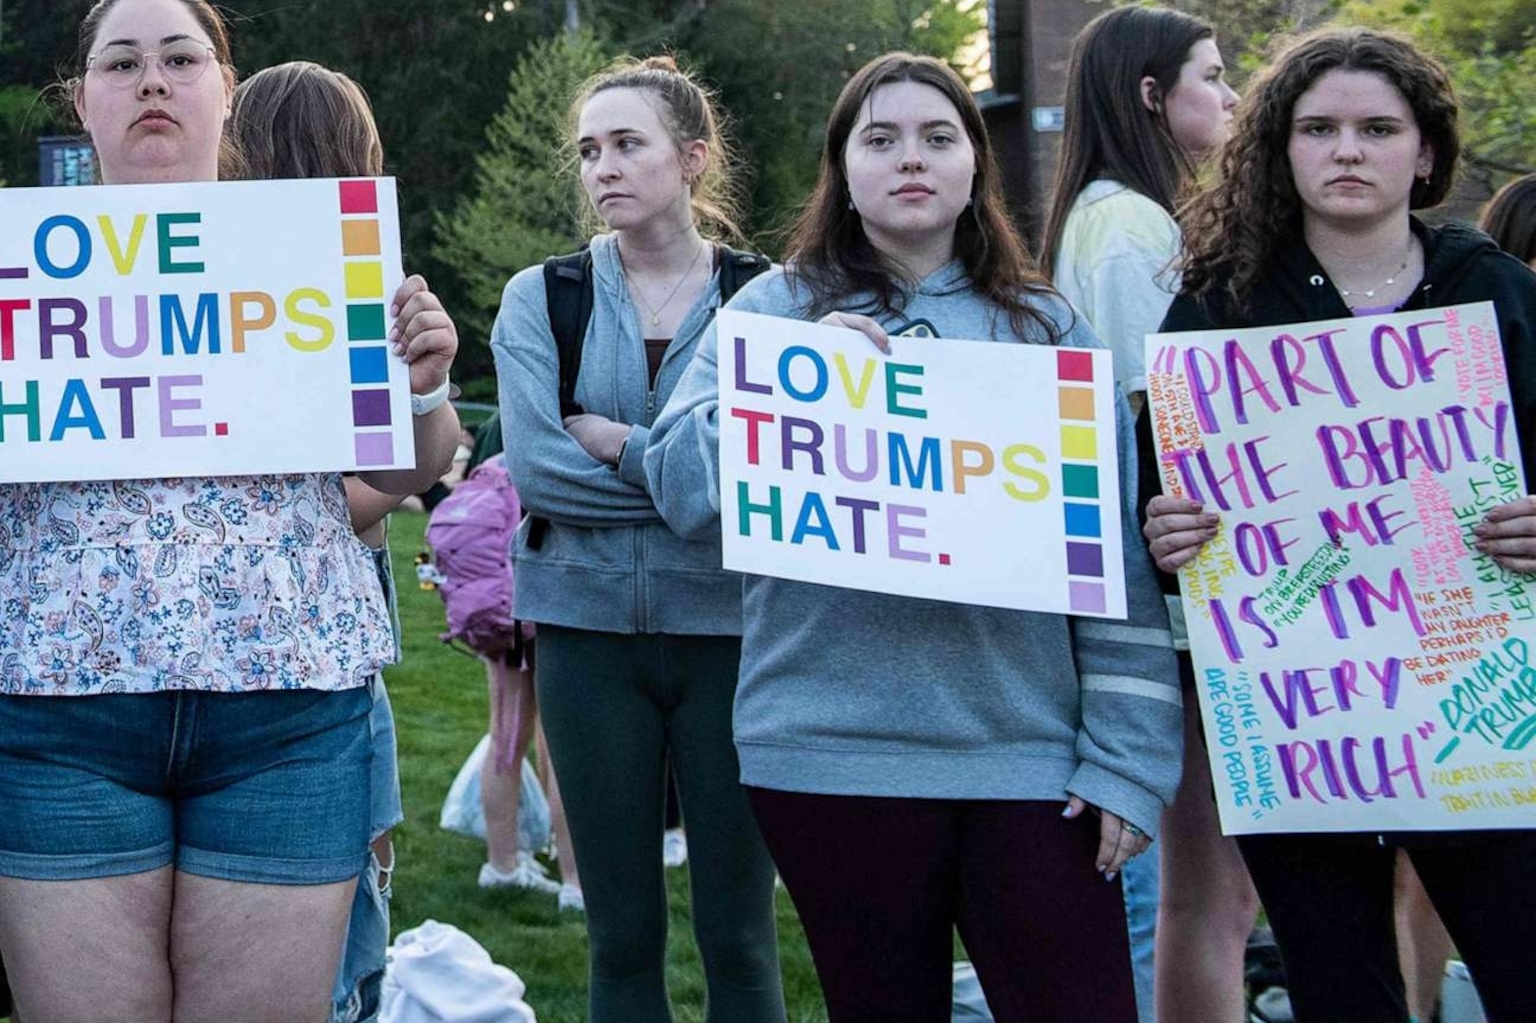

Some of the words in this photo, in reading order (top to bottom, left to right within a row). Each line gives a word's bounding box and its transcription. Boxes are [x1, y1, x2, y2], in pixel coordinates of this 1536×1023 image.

[734, 337, 928, 419] LOVE
[1371, 319, 1451, 389] OF
[731, 408, 1050, 502] TRUMPS
[1162, 436, 1300, 514] THE
[1317, 402, 1508, 490] BEAUTY
[736, 481, 951, 565] HATE.
[1235, 518, 1300, 577] OF
[1318, 494, 1418, 552] ME
[1209, 596, 1277, 663] IS
[1441, 586, 1474, 602] SHE
[1403, 657, 1422, 671] BE
[1419, 630, 1485, 651] PERHAPS
[1204, 668, 1231, 702] ARE
[1260, 657, 1402, 730] VERY
[1440, 637, 1528, 731] DONALD
[1464, 665, 1536, 744] TRUMP
[1214, 702, 1239, 747] GOOD
[1250, 744, 1282, 810] ASSUME
